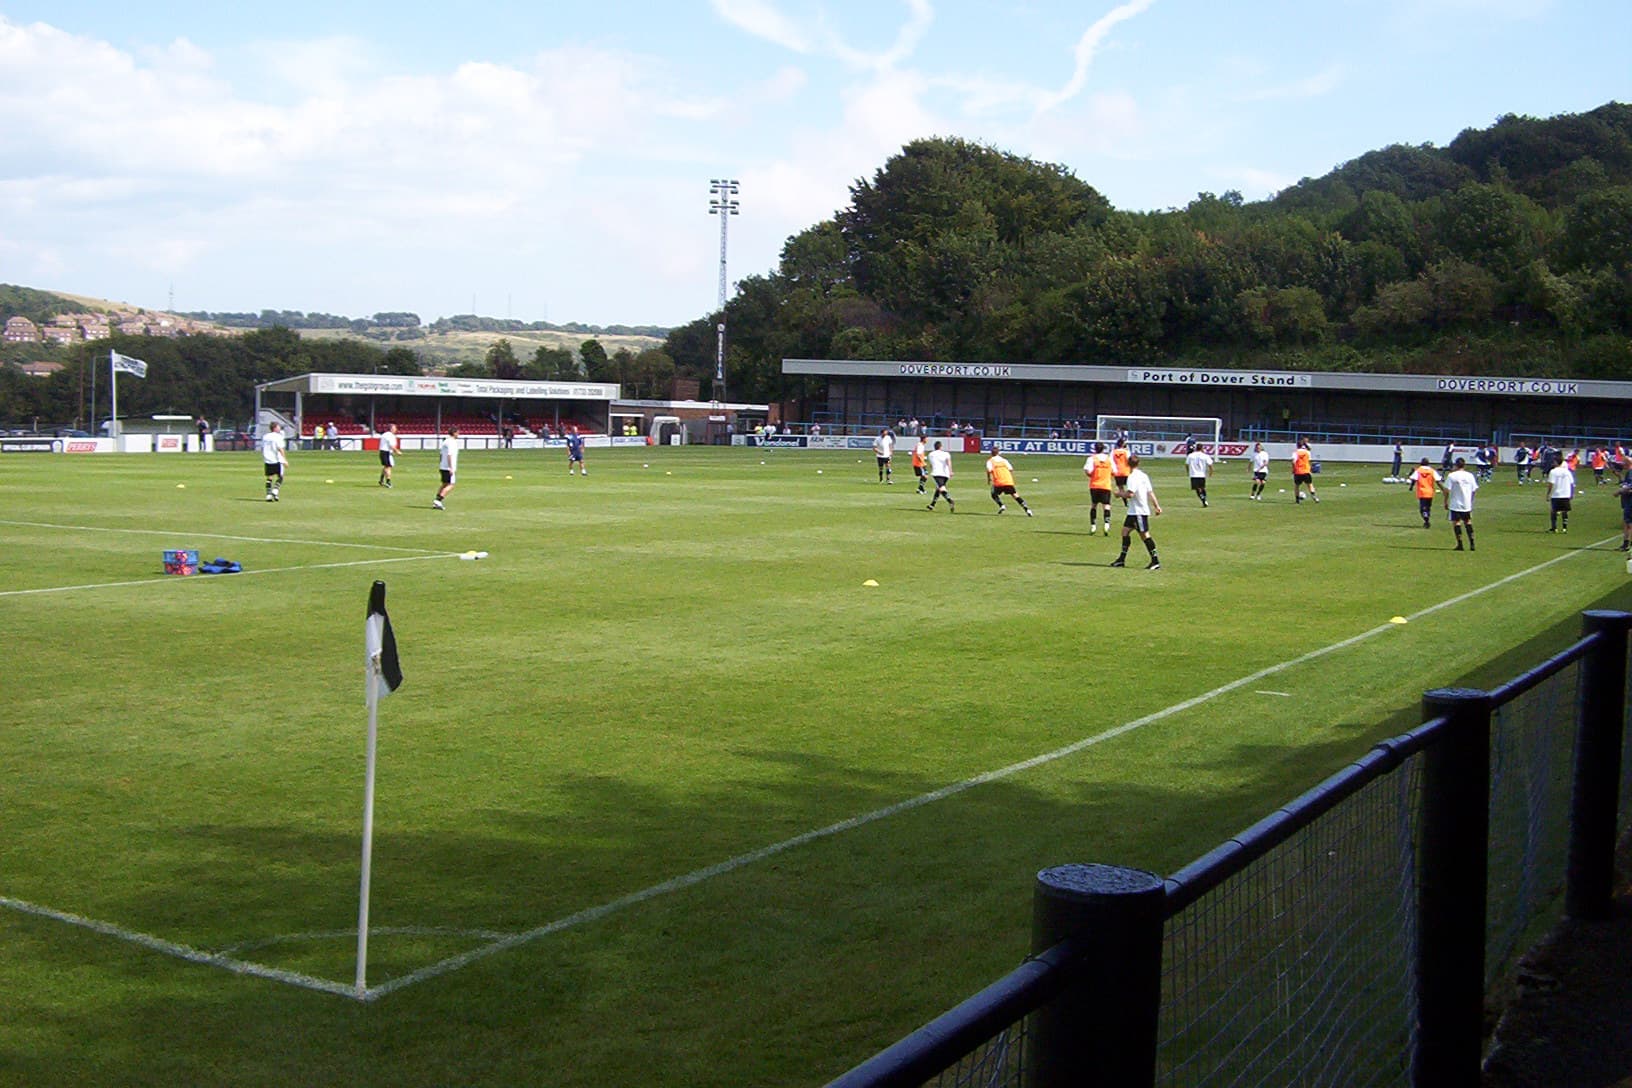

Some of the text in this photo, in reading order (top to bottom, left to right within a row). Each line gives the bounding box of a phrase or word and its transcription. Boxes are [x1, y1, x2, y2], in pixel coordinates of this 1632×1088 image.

[899, 364, 1010, 377] DOVERPORT.CO.UK
[1142, 371, 1296, 386] Port of Dover Stand
[1438, 378, 1578, 394] DOVERPORT.CO.UK
[993, 441, 1021, 451] BET
[1024, 441, 1044, 451] AT
[1047, 442, 1086, 453] BLUE
